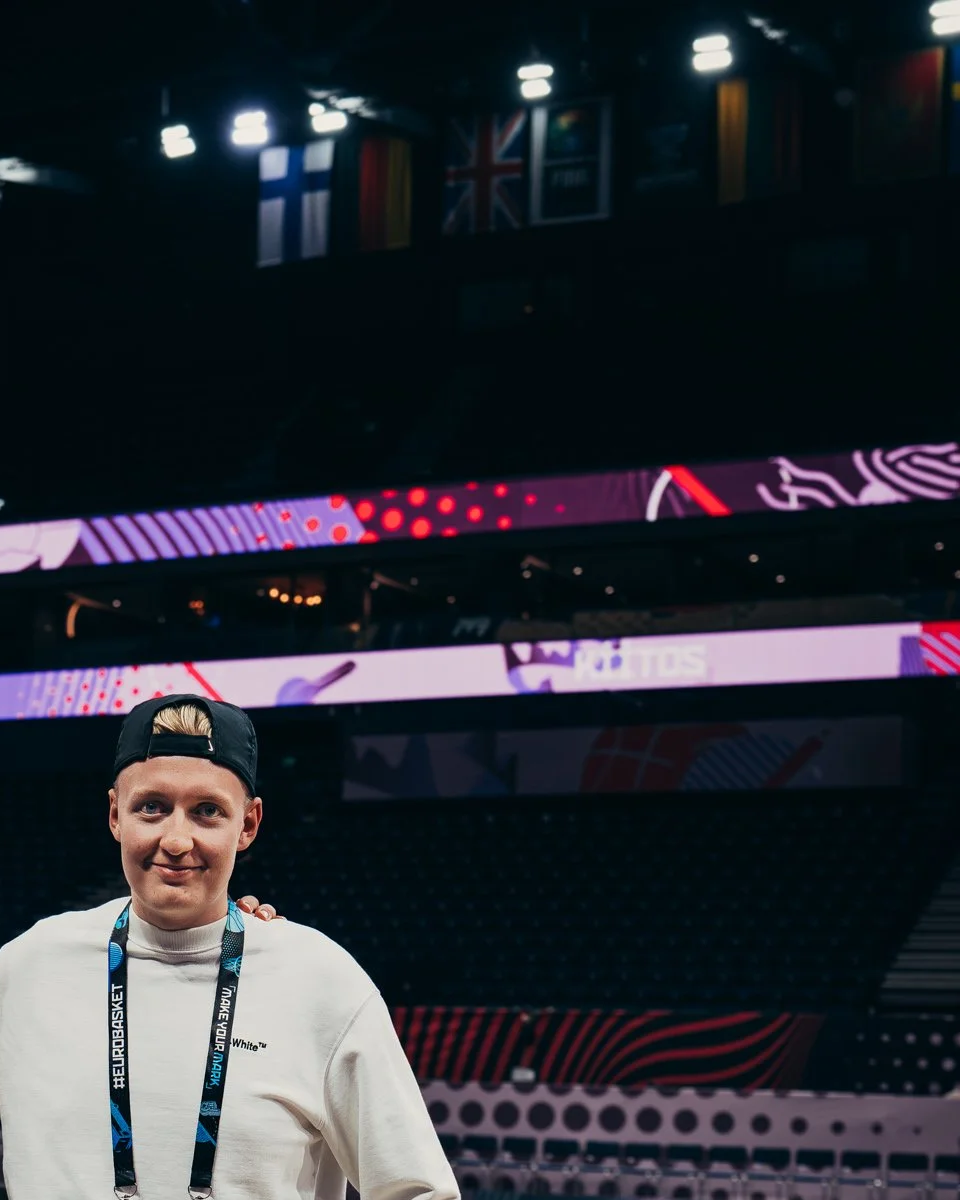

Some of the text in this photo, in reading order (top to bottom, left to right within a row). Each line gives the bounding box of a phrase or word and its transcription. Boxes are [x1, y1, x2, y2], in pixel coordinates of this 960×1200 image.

[112, 983, 125, 1090] #EUROBASKET
[209, 987, 232, 1086] MAKE YOUR MARK
